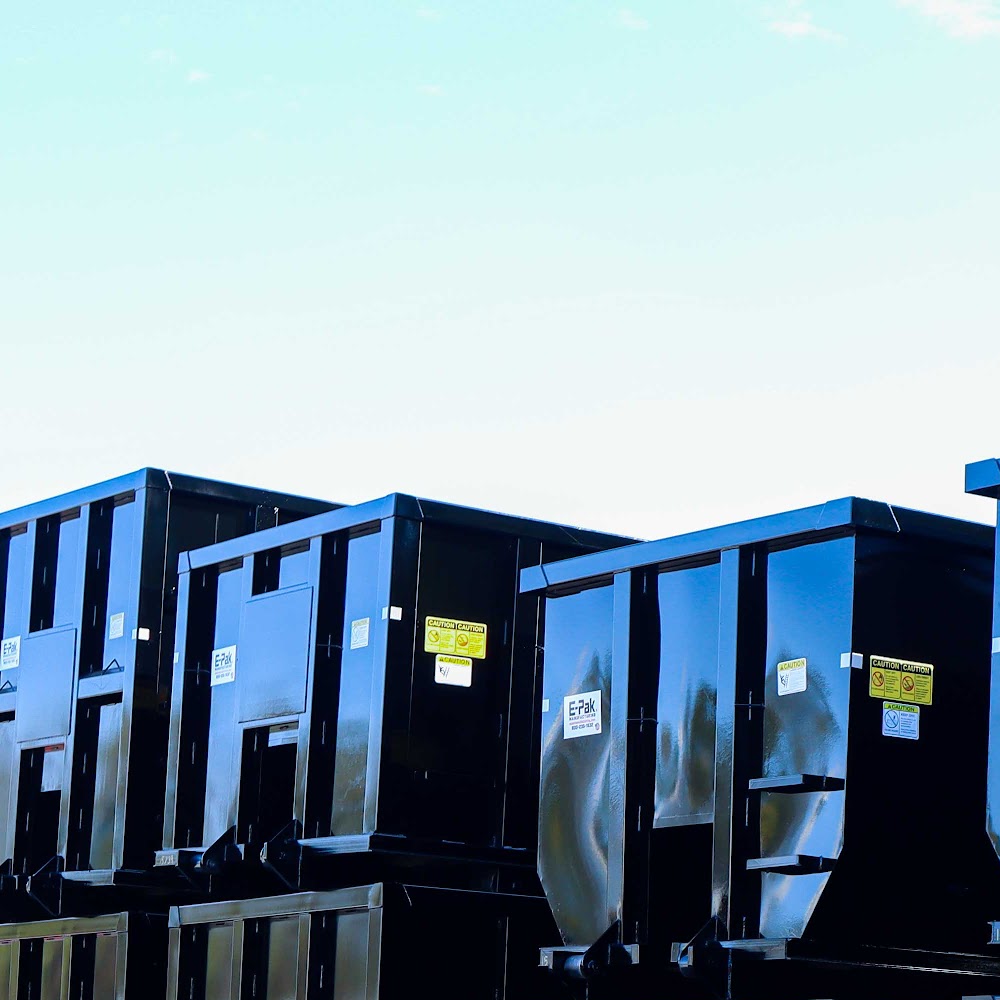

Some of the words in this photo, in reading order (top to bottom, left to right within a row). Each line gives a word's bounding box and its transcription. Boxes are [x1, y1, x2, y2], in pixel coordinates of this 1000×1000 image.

[428, 620, 455, 629] CAUTION
[457, 624, 484, 633] CAUTION
[215, 651, 232, 667] E-Pak
[872, 660, 900, 670] CAUTION
[903, 665, 930, 674] CAUTION
[569, 698, 596, 716] E-Pak
